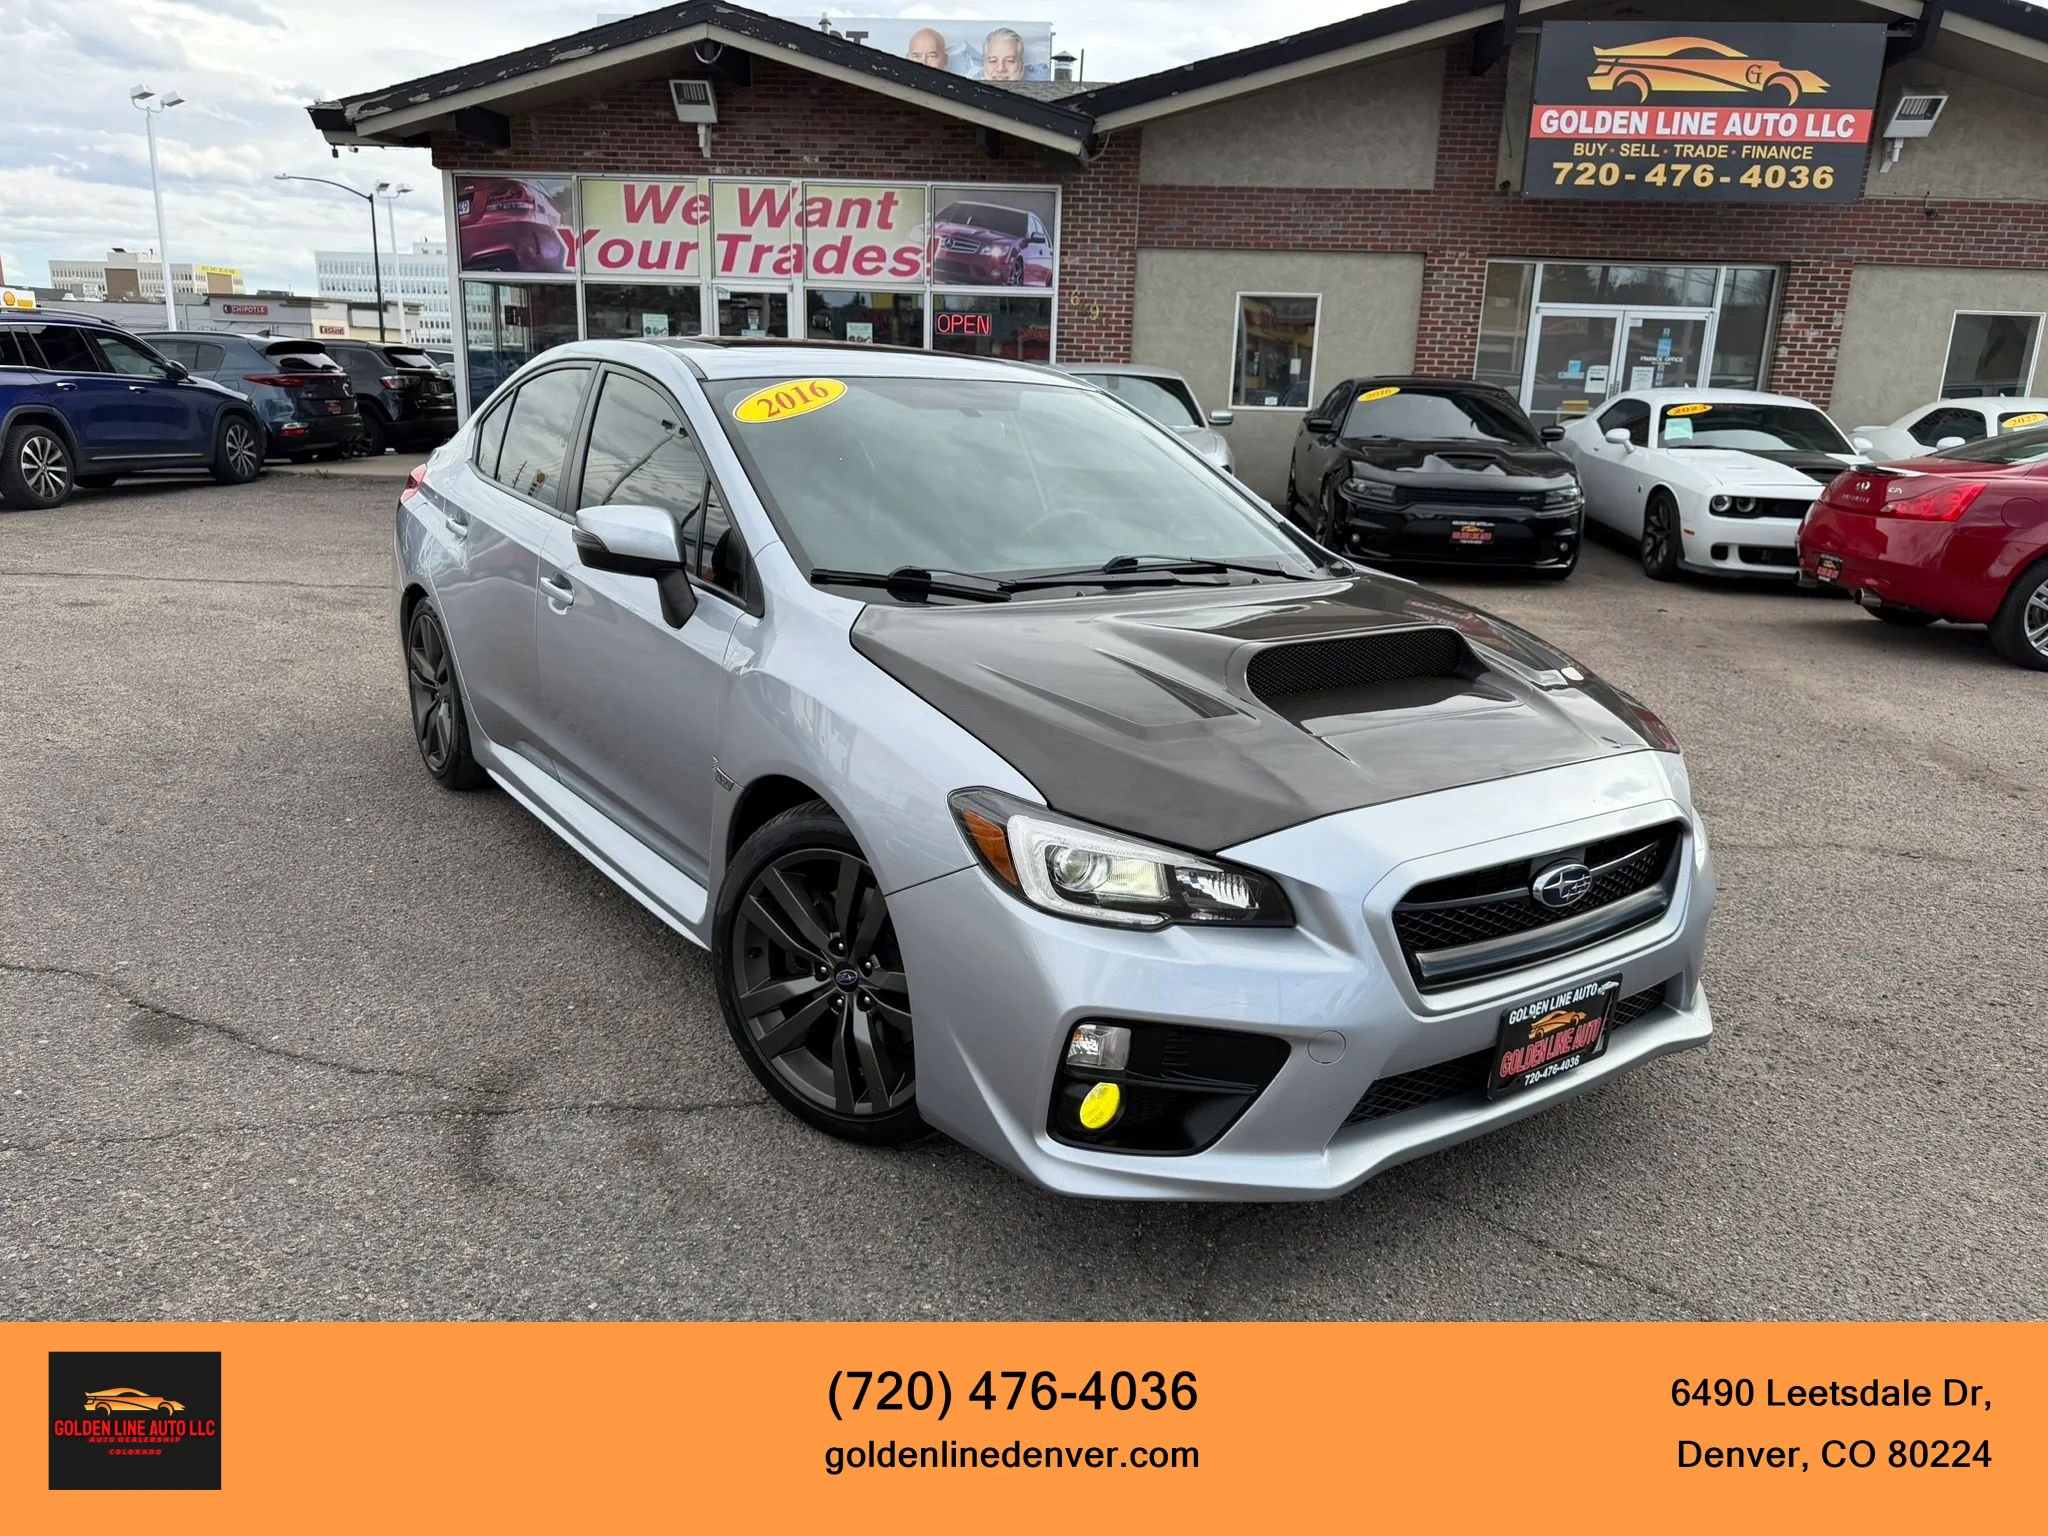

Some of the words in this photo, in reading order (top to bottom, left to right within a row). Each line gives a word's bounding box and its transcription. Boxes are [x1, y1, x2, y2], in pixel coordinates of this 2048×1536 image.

[1540, 109, 1649, 135] GOLDEN
[1655, 111, 1718, 136] LINE
[1722, 112, 1798, 138] AUTO
[1804, 114, 1856, 138] LLC
[1573, 143, 1608, 156] BUY
[1619, 144, 1660, 157] SELL
[1674, 144, 1729, 159] TRADE
[1741, 145, 1814, 160] FINANCE
[623, 183, 712, 226] We
[737, 187, 899, 230] Want
[557, 228, 699, 270] Your
[231, 304, 265, 315] CHIPOTLE
[937, 313, 991, 335] OPEN
[757, 380, 829, 418] 2016
[1508, 998, 1550, 1025] GOLDEN
[1549, 990, 1573, 1013] LINE
[1572, 982, 1599, 1003] AUTO
[1500, 1036, 1550, 1078] GOLDEN
[1545, 1027, 1575, 1061] LINE
[1571, 1016, 1603, 1051] AUTO
[1524, 1055, 1581, 1087] 720-476-4036
